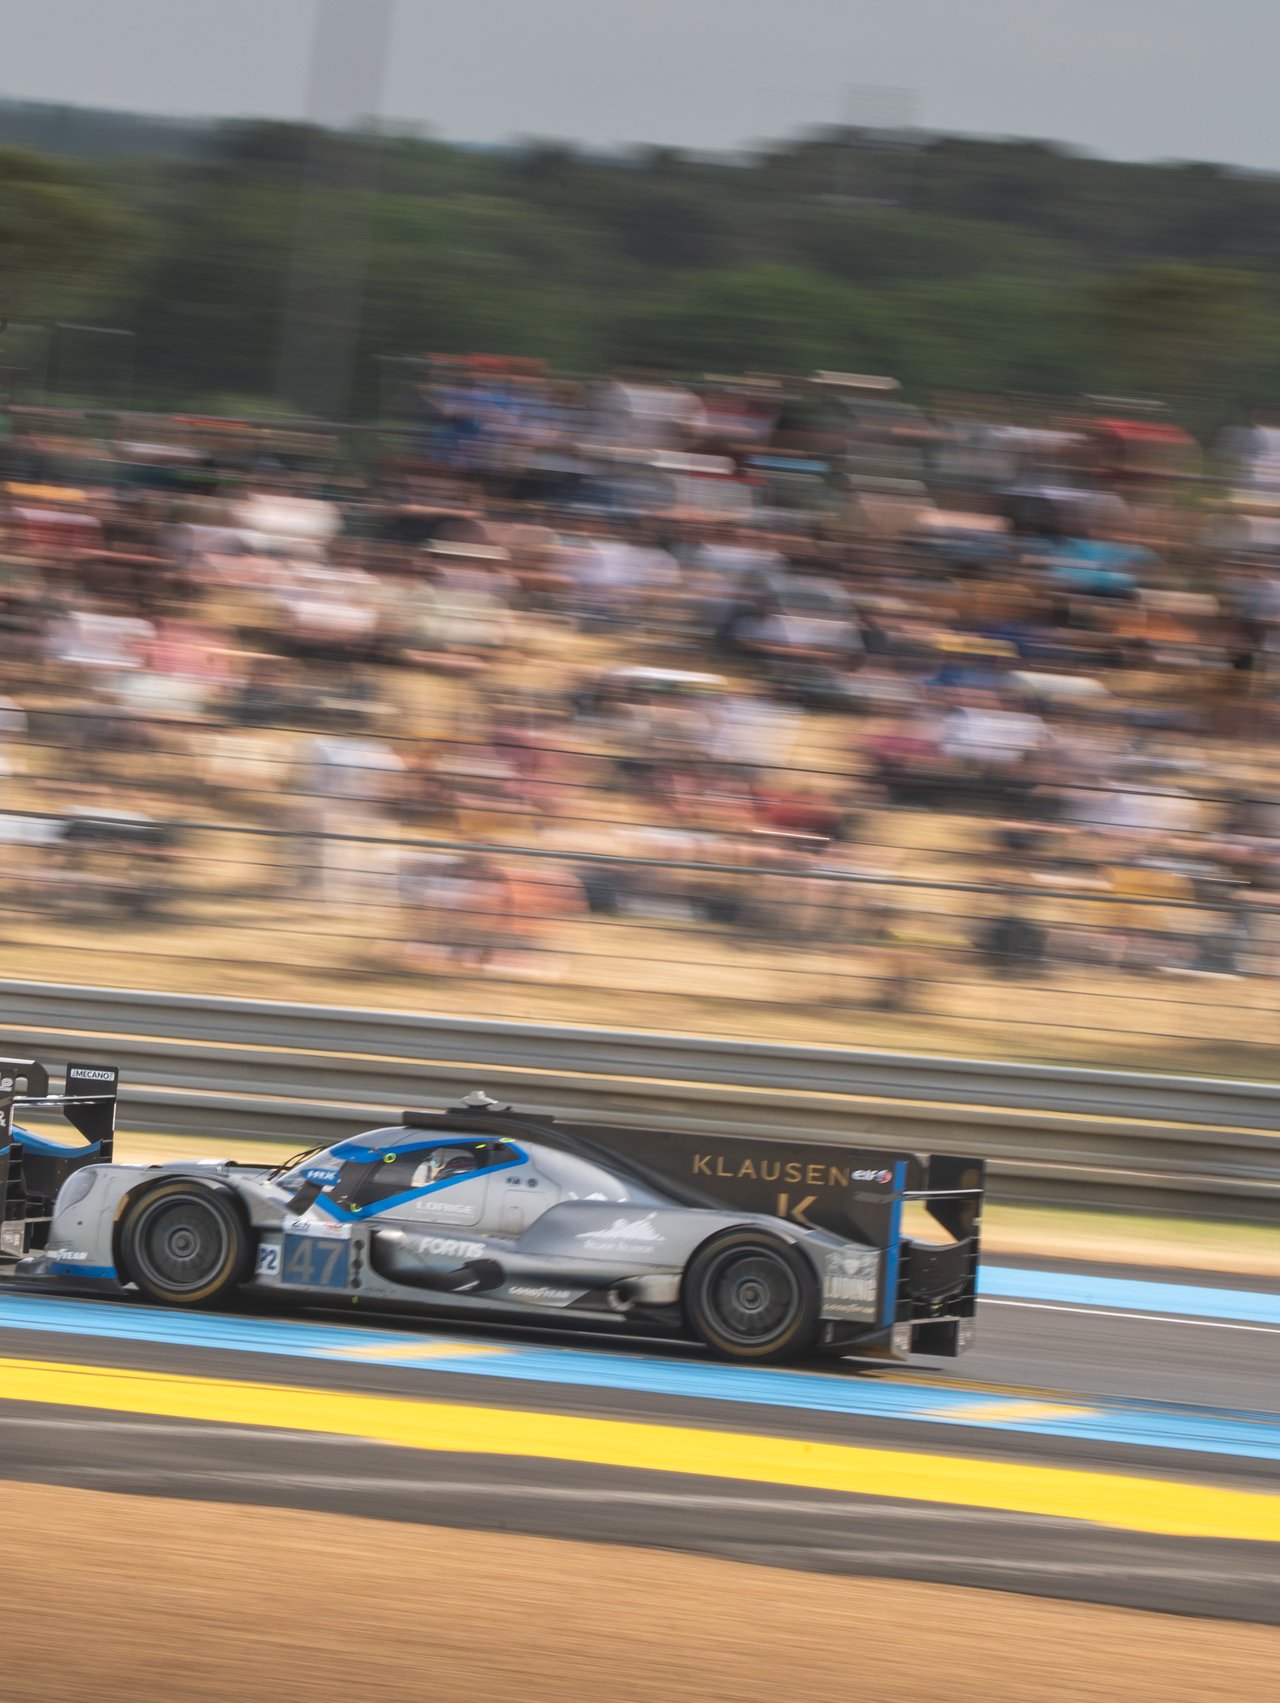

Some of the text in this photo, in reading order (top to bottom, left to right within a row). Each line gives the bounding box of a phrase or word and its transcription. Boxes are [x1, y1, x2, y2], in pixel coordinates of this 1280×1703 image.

[74, 1070, 110, 1080] MECANO
[691, 1153, 850, 1187] KLAUSEN
[776, 1193, 818, 1224] K
[287, 1239, 344, 1284] 47
[419, 1236, 488, 1258] FORTIS
